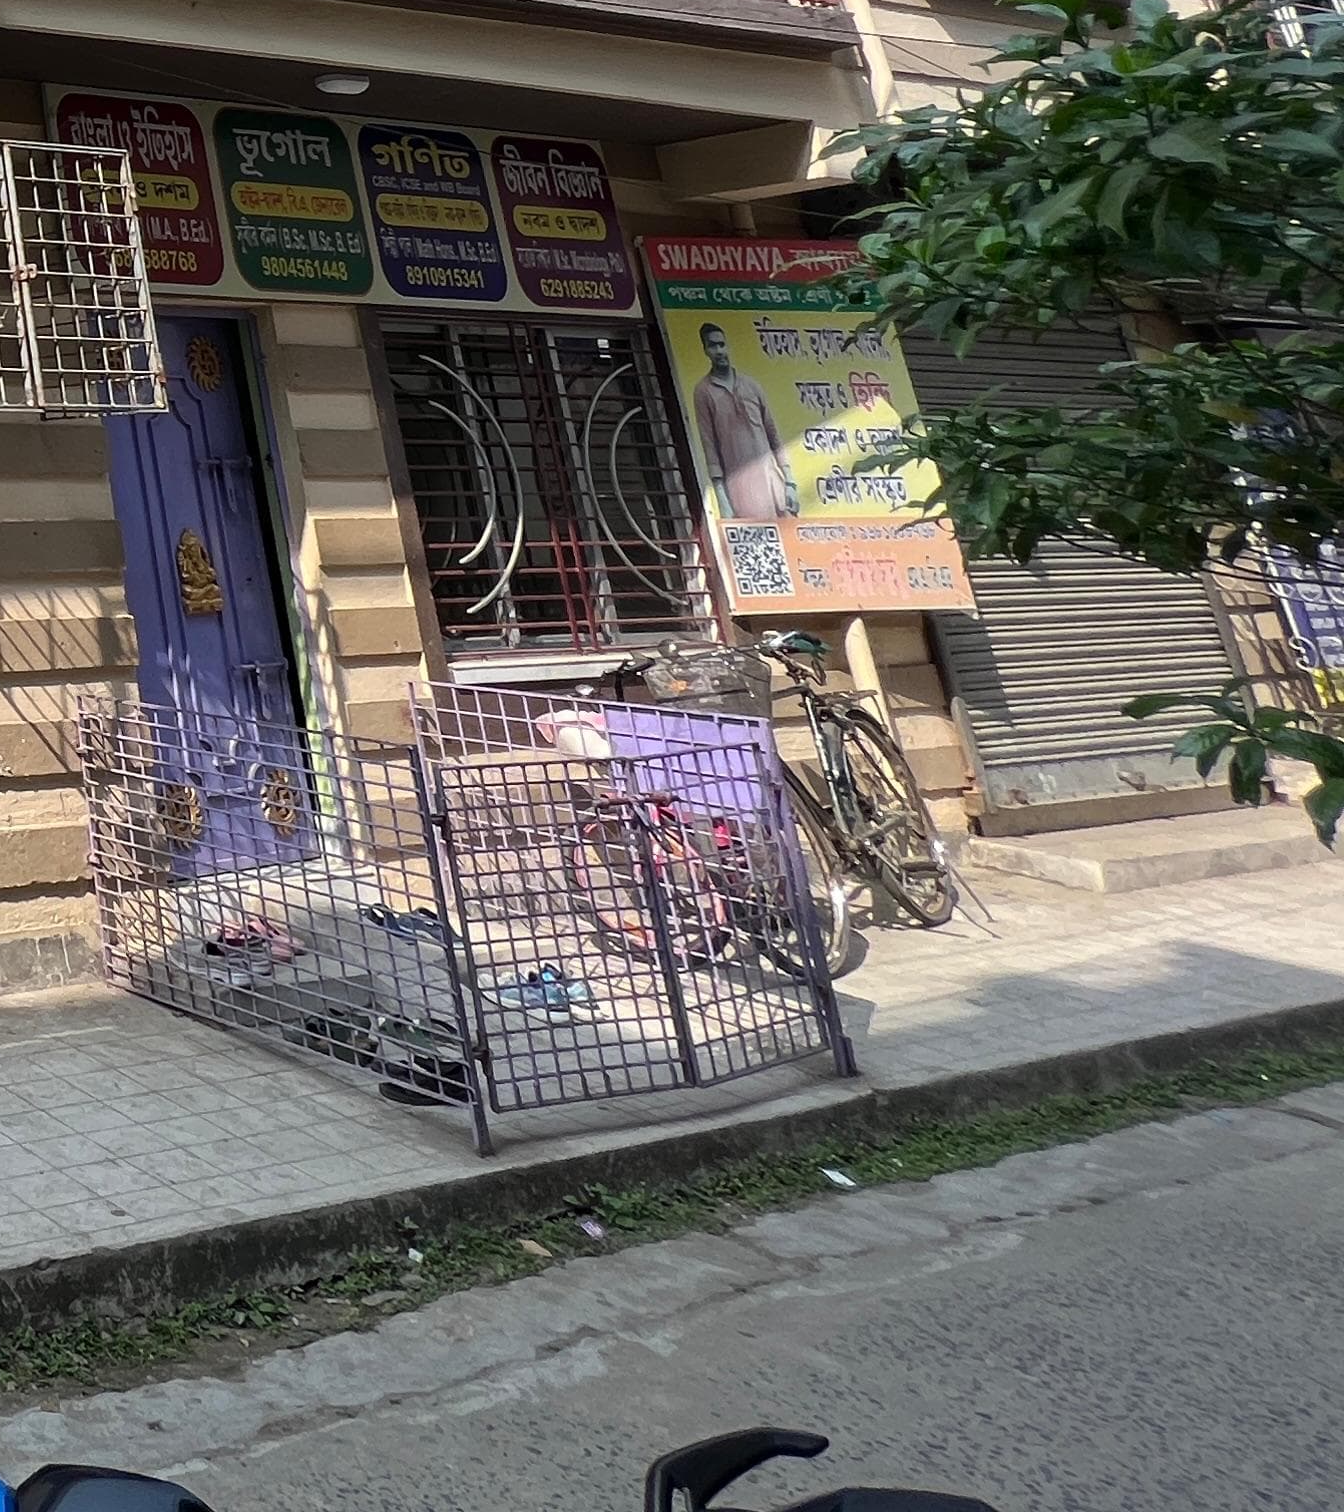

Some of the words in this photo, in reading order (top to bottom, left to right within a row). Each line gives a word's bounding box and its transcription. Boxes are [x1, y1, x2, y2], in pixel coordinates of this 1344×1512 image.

[131, 105, 195, 171] ইতিহাস
[232, 128, 331, 176] ভূগোল
[371, 135, 470, 179] গণিত
[500, 145, 548, 197] জীবন
[547, 149, 605, 200] বিজ্ঞান
[105, 247, 198, 273] 68588768
[261, 256, 348, 281] 9804561448
[657, 244, 784, 272] SWADHYAYA
[406, 265, 484, 288] 8910915341
[713, 288, 752, 303] থেকে
